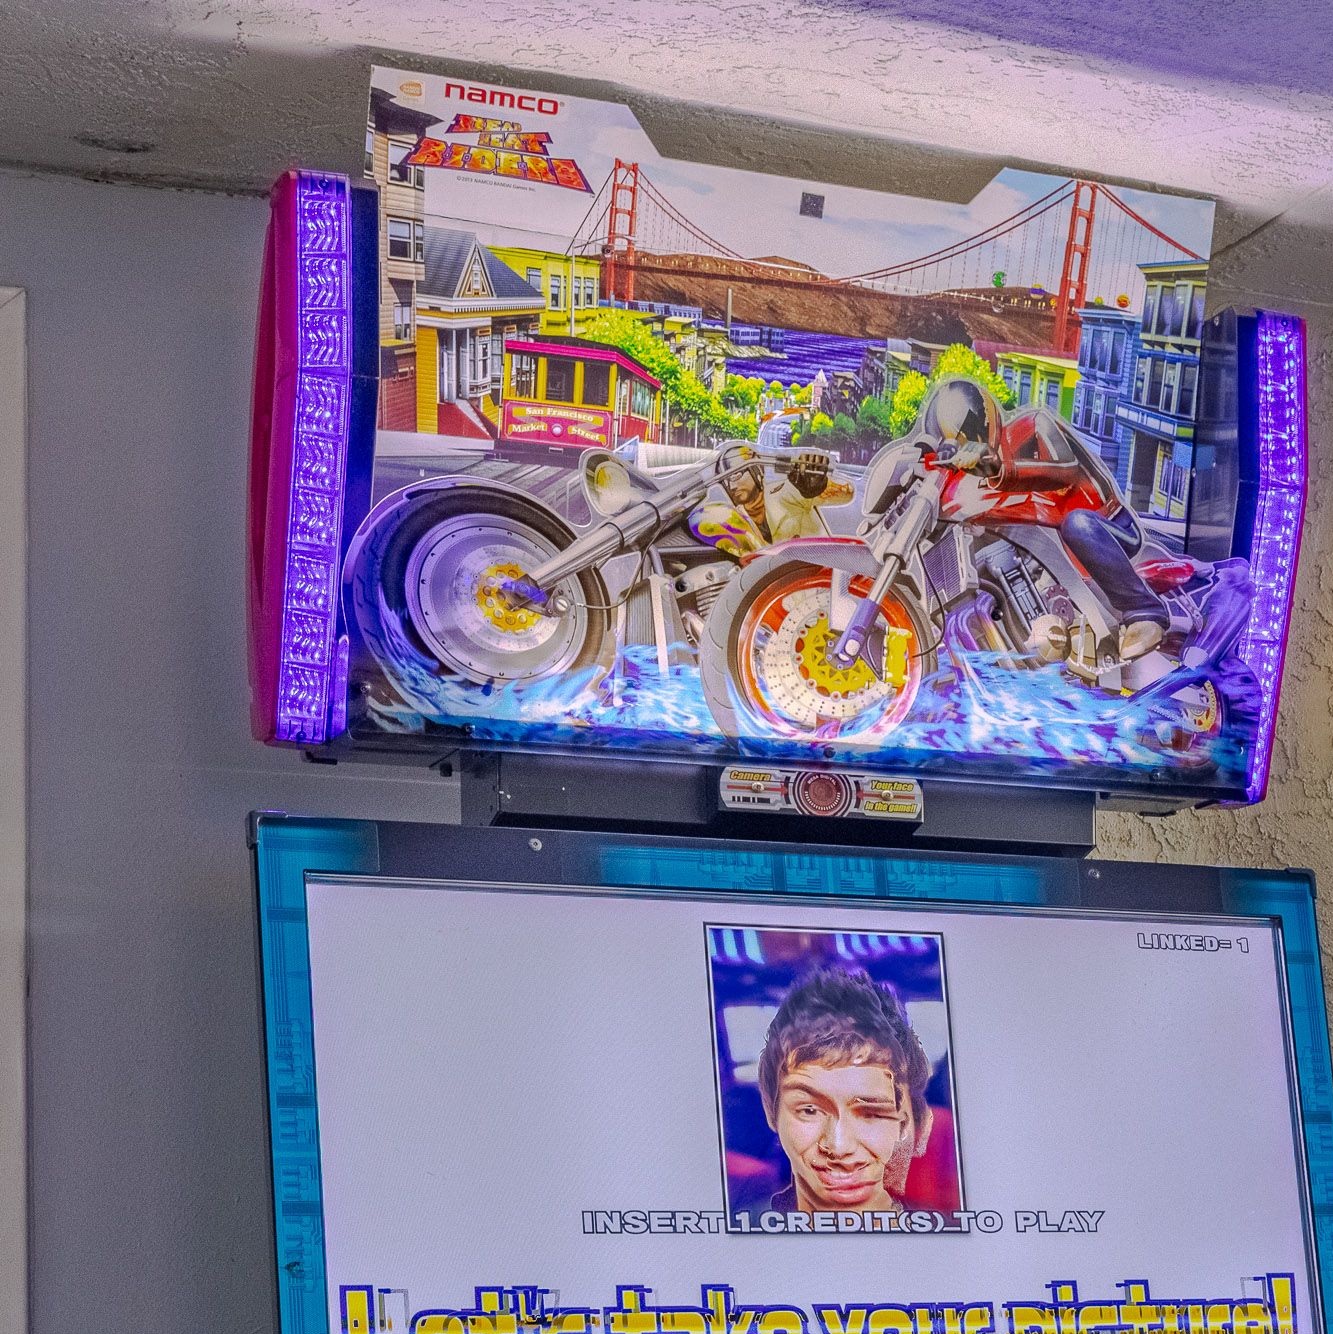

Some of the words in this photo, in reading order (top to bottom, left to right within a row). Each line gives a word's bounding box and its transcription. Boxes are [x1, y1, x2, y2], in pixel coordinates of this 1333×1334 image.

[444, 82, 559, 116] namco
[477, 131, 553, 156] HEAT
[405, 136, 595, 194] RIDERS
[525, 407, 544, 416] San
[546, 408, 594, 422] Francisco
[511, 423, 545, 433] Market
[571, 426, 600, 441] Street
[729, 770, 772, 782] Camera
[870, 780, 893, 792] Your
[893, 782, 914, 791] face
[864, 801, 874, 811] in
[874, 801, 888, 812] the
[1237, 937, 1249, 953] 1
[582, 1210, 726, 1234] INSERT
[734, 1210, 756, 1233] 1
[759, 1210, 946, 1234] CREDIT(S)
[959, 1210, 1003, 1233] TO
[1016, 1210, 1105, 1233] PLAY
